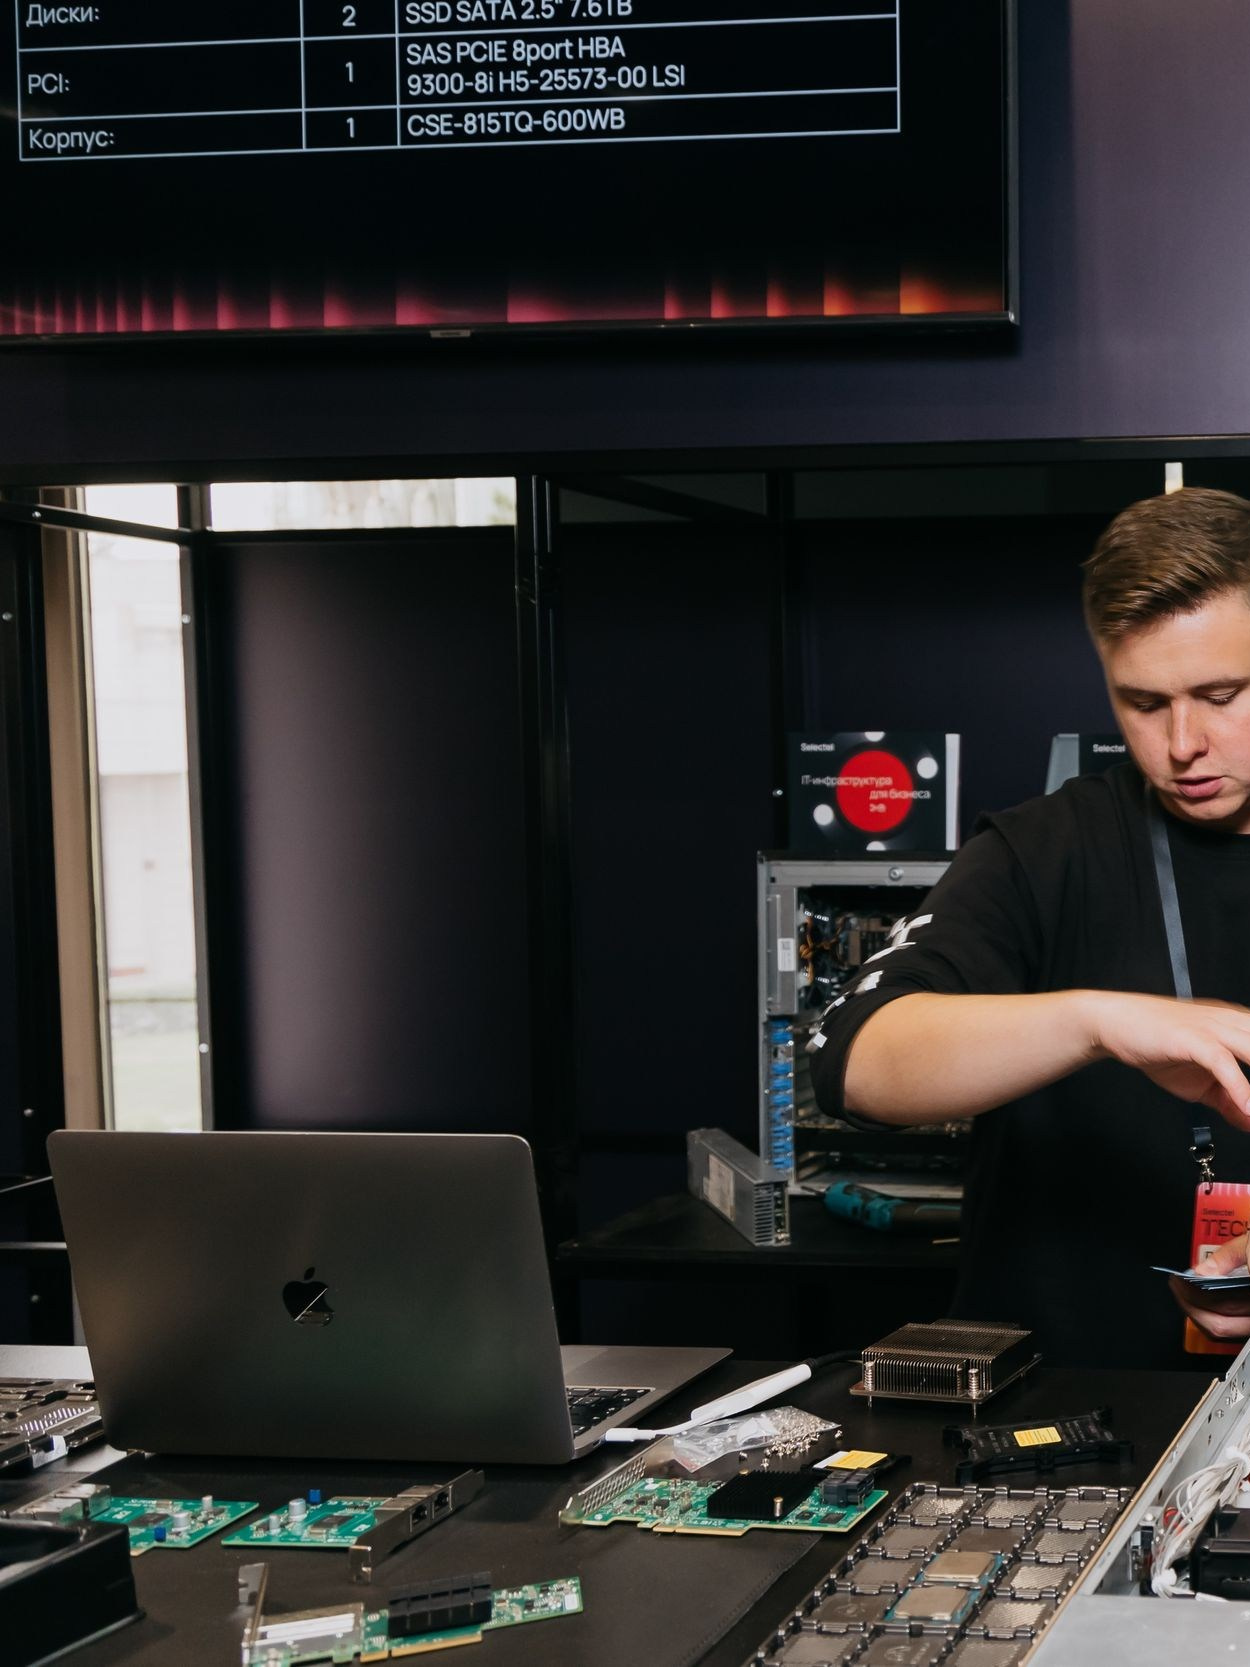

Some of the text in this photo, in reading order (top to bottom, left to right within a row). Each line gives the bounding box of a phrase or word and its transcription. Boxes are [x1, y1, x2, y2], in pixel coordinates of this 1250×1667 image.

[26, 4, 100, 27] Диски:
[342, 5, 357, 27] 2
[405, 2, 451, 24] SSD
[456, 0, 516, 22] SATA
[406, 36, 626, 66] SAS PCIE 8port HBA
[27, 73, 70, 95] PCI:
[345, 62, 354, 83] 1
[407, 64, 686, 96] 9300-8i H5-25573-00 LSI
[346, 117, 355, 138] 1
[407, 107, 626, 137] CSE-815TQ-600WB
[29, 129, 114, 153] Корпус:
[800, 742, 835, 752] Selectel
